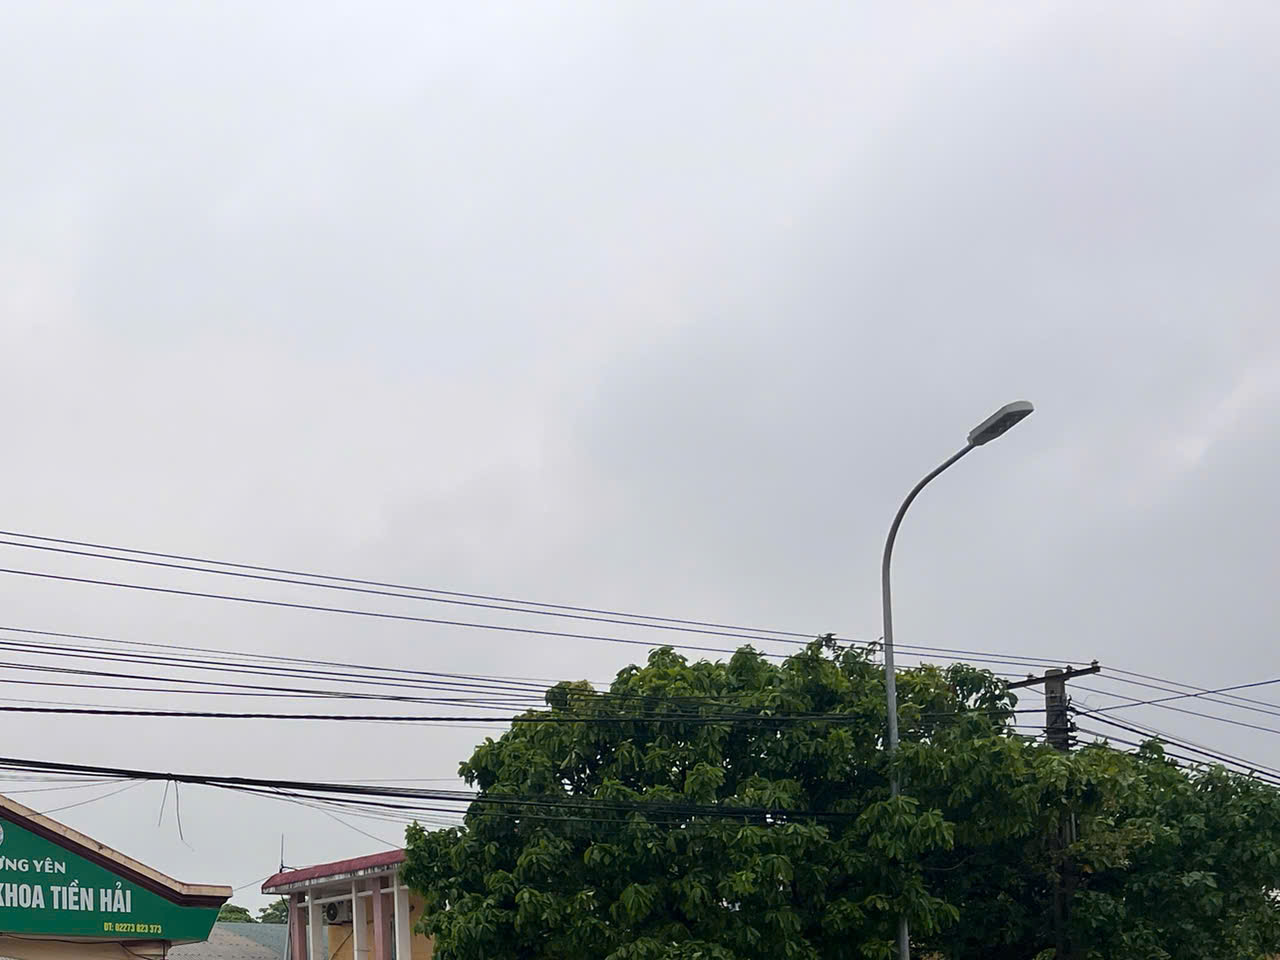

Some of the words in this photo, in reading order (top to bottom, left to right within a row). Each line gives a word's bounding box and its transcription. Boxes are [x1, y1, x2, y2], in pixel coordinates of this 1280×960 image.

[32, 857, 66, 874] YÊN
[49, 879, 94, 911] TIỀN
[99, 881, 131, 913] HẢI
